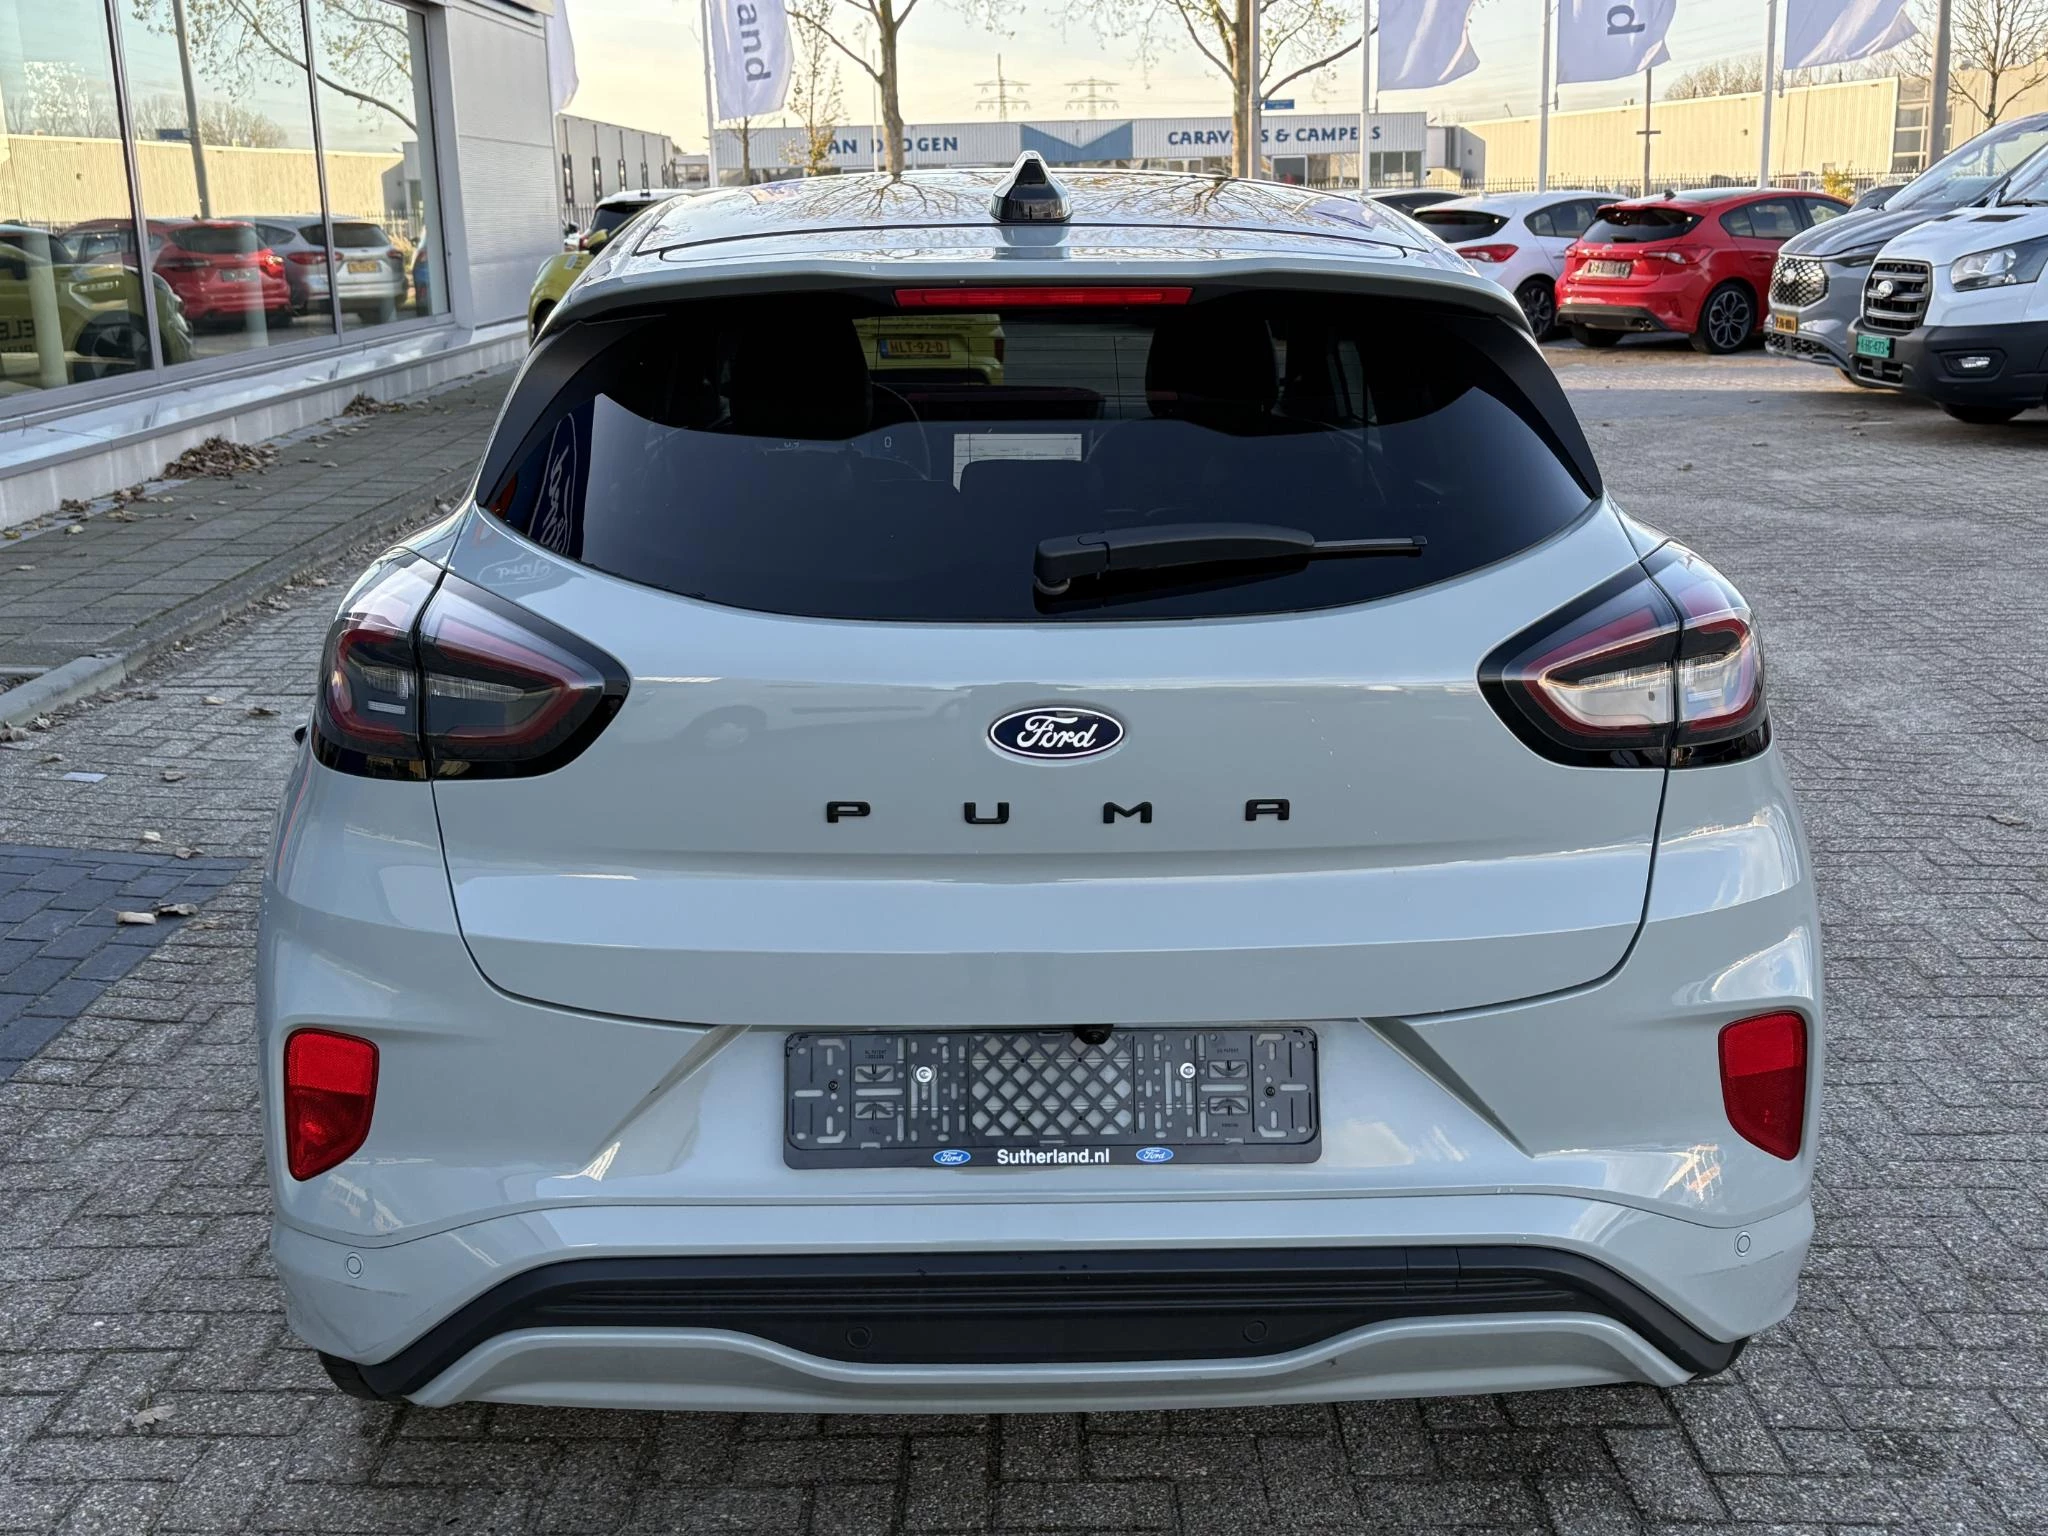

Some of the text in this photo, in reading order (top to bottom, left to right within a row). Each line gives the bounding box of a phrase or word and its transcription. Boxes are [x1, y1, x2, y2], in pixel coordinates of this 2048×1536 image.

[1168, 126, 1381, 145] CARAVS & CAMPES
[826, 136, 958, 154] AN DOGEN
[1016, 714, 1098, 748] Ford
[826, 799, 1290, 824] PUMA
[940, 1151, 964, 1162] Ford
[997, 1148, 1110, 1165] Sutherland.nl
[1143, 1149, 1165, 1160] Ford
